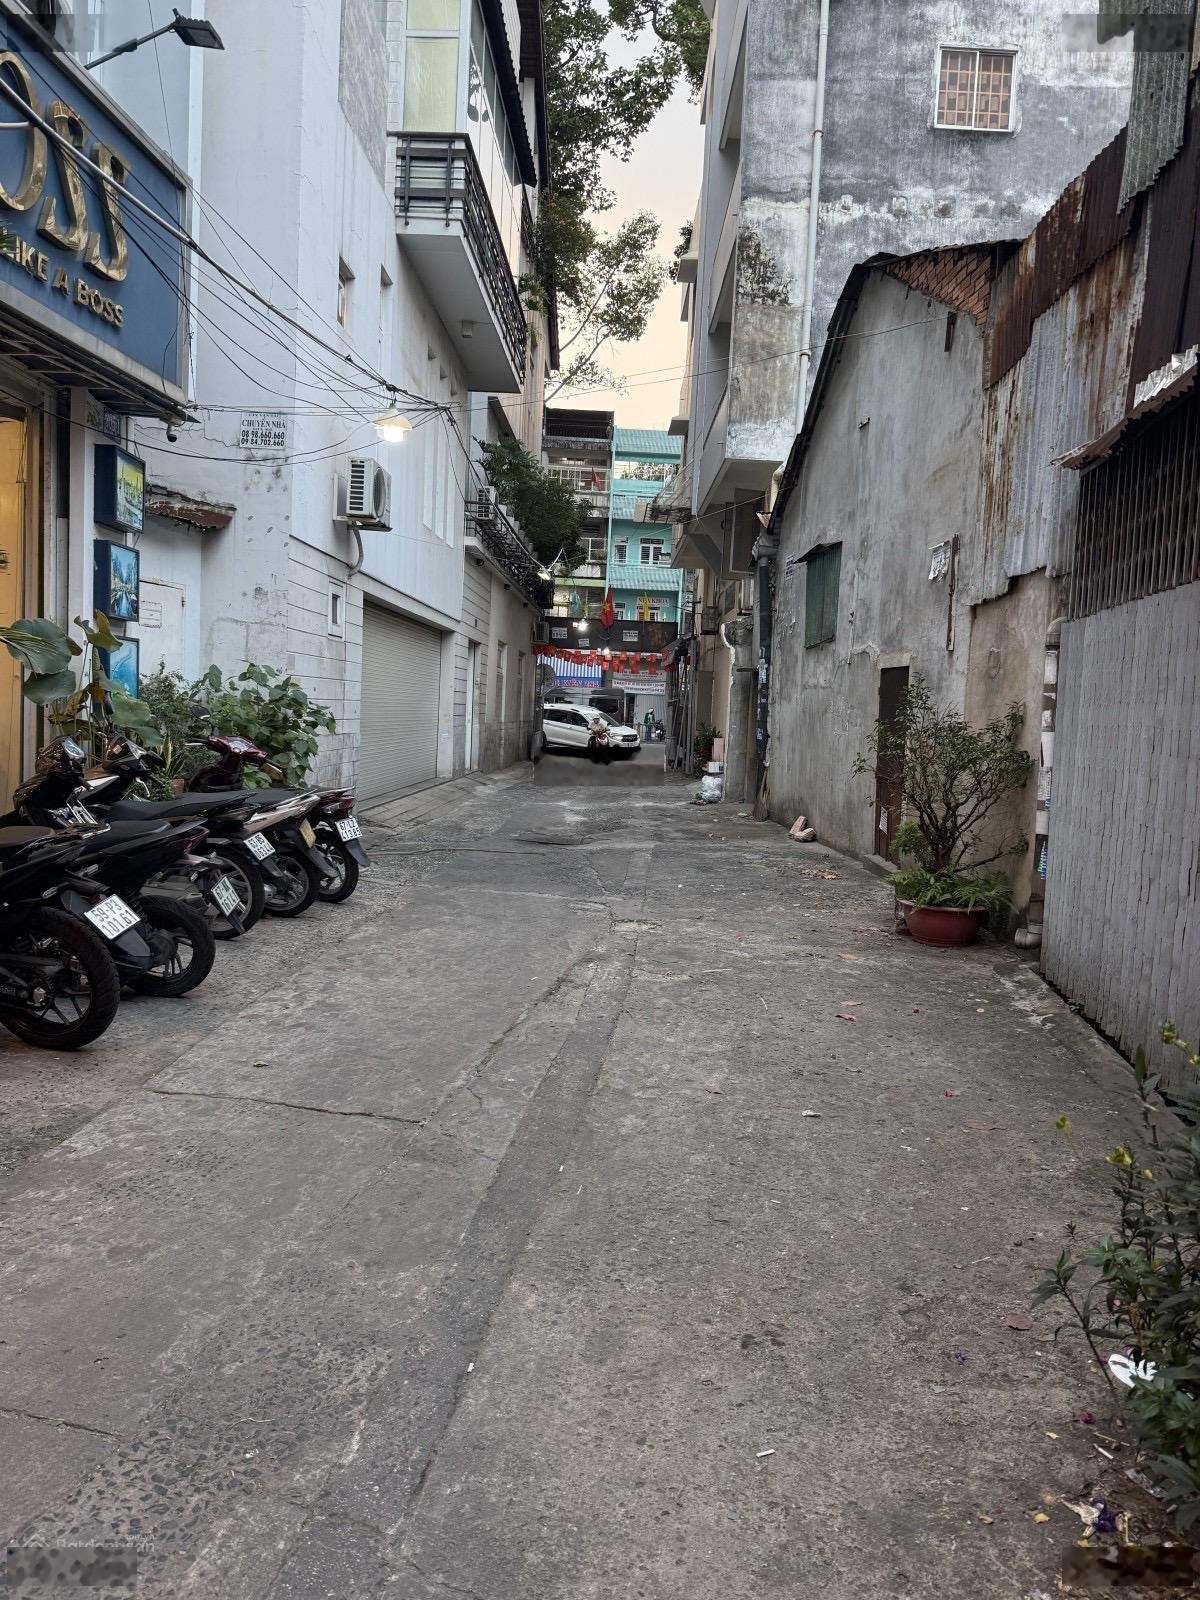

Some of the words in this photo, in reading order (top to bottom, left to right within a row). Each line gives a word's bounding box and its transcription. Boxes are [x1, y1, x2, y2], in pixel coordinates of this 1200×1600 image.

[52, 267, 69, 296] A
[74, 277, 124, 328] BOSS
[241, 430, 249, 438] 08
[90, 898, 123, 922] 59-P3
[101, 909, 138, 936] 101.61
